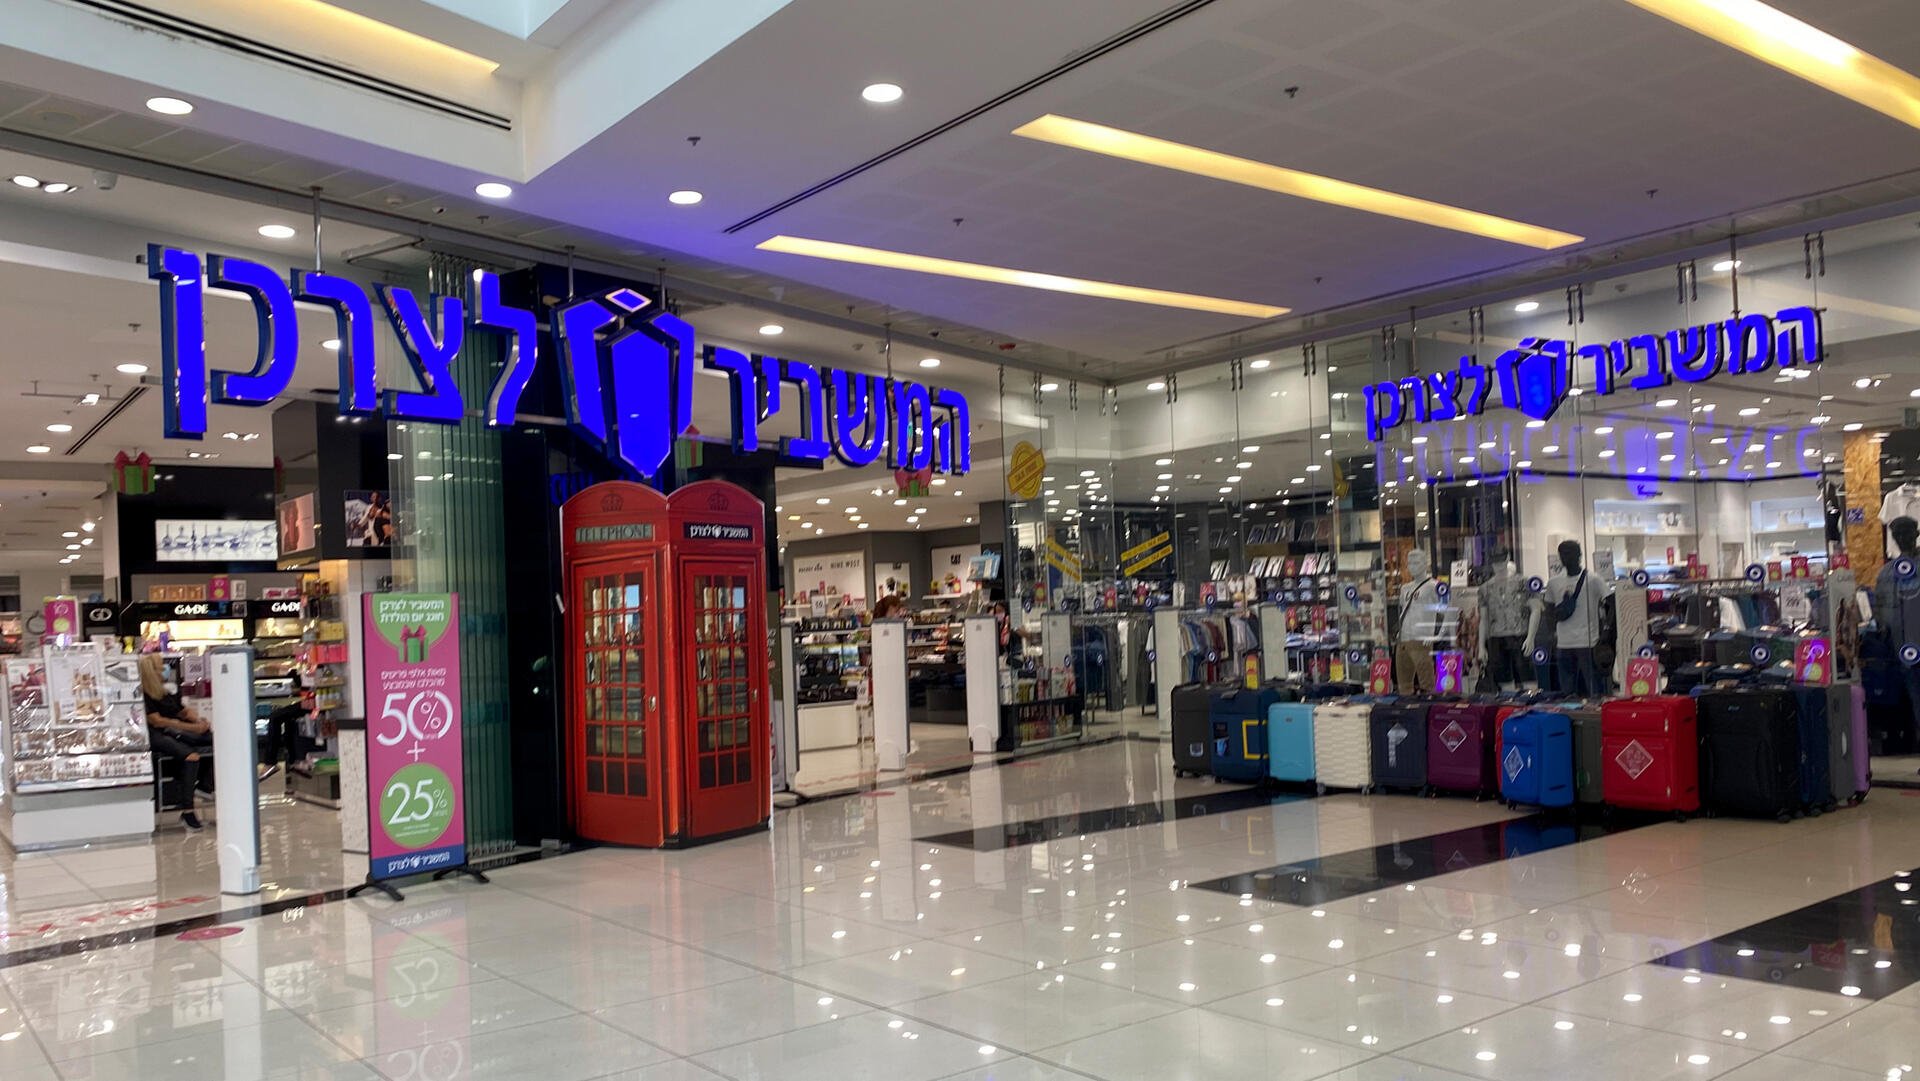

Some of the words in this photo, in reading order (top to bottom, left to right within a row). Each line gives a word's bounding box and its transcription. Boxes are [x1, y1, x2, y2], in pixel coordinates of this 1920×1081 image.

[147, 243, 538, 439] לצרכן
[1577, 305, 1827, 395] המשביר
[704, 344, 970, 476] המשביר
[1361, 354, 1493, 441] לצרכן
[578, 523, 651, 542] TELEPHONE
[411, 612, 424, 622] יום
